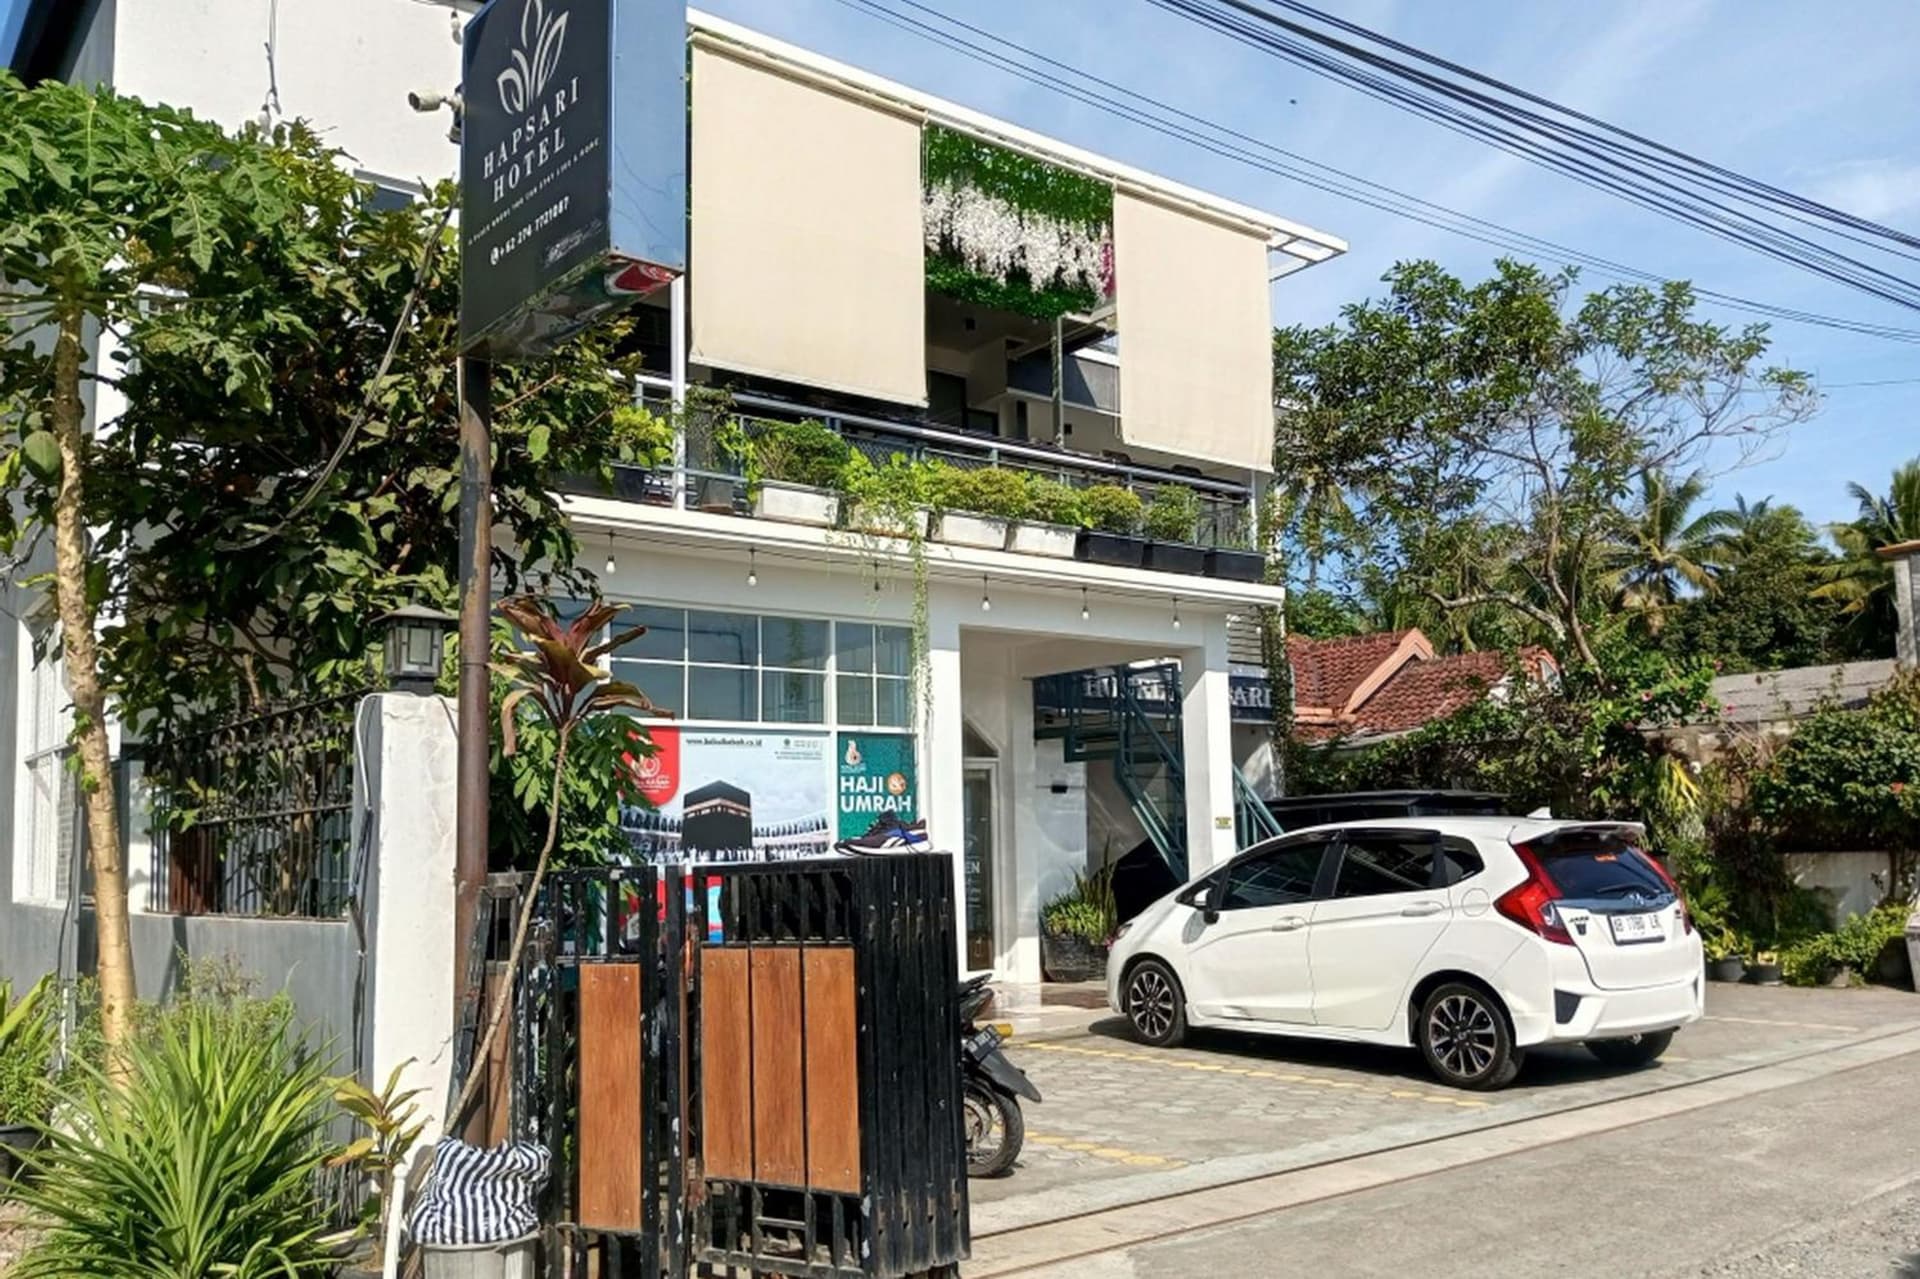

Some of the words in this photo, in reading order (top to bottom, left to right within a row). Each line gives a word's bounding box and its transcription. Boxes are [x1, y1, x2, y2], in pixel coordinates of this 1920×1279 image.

[483, 76, 580, 180] HAPSARI
[493, 127, 566, 202] HOTEL
[841, 775, 884, 793] HAJI
[841, 795, 912, 813] UMRAH
